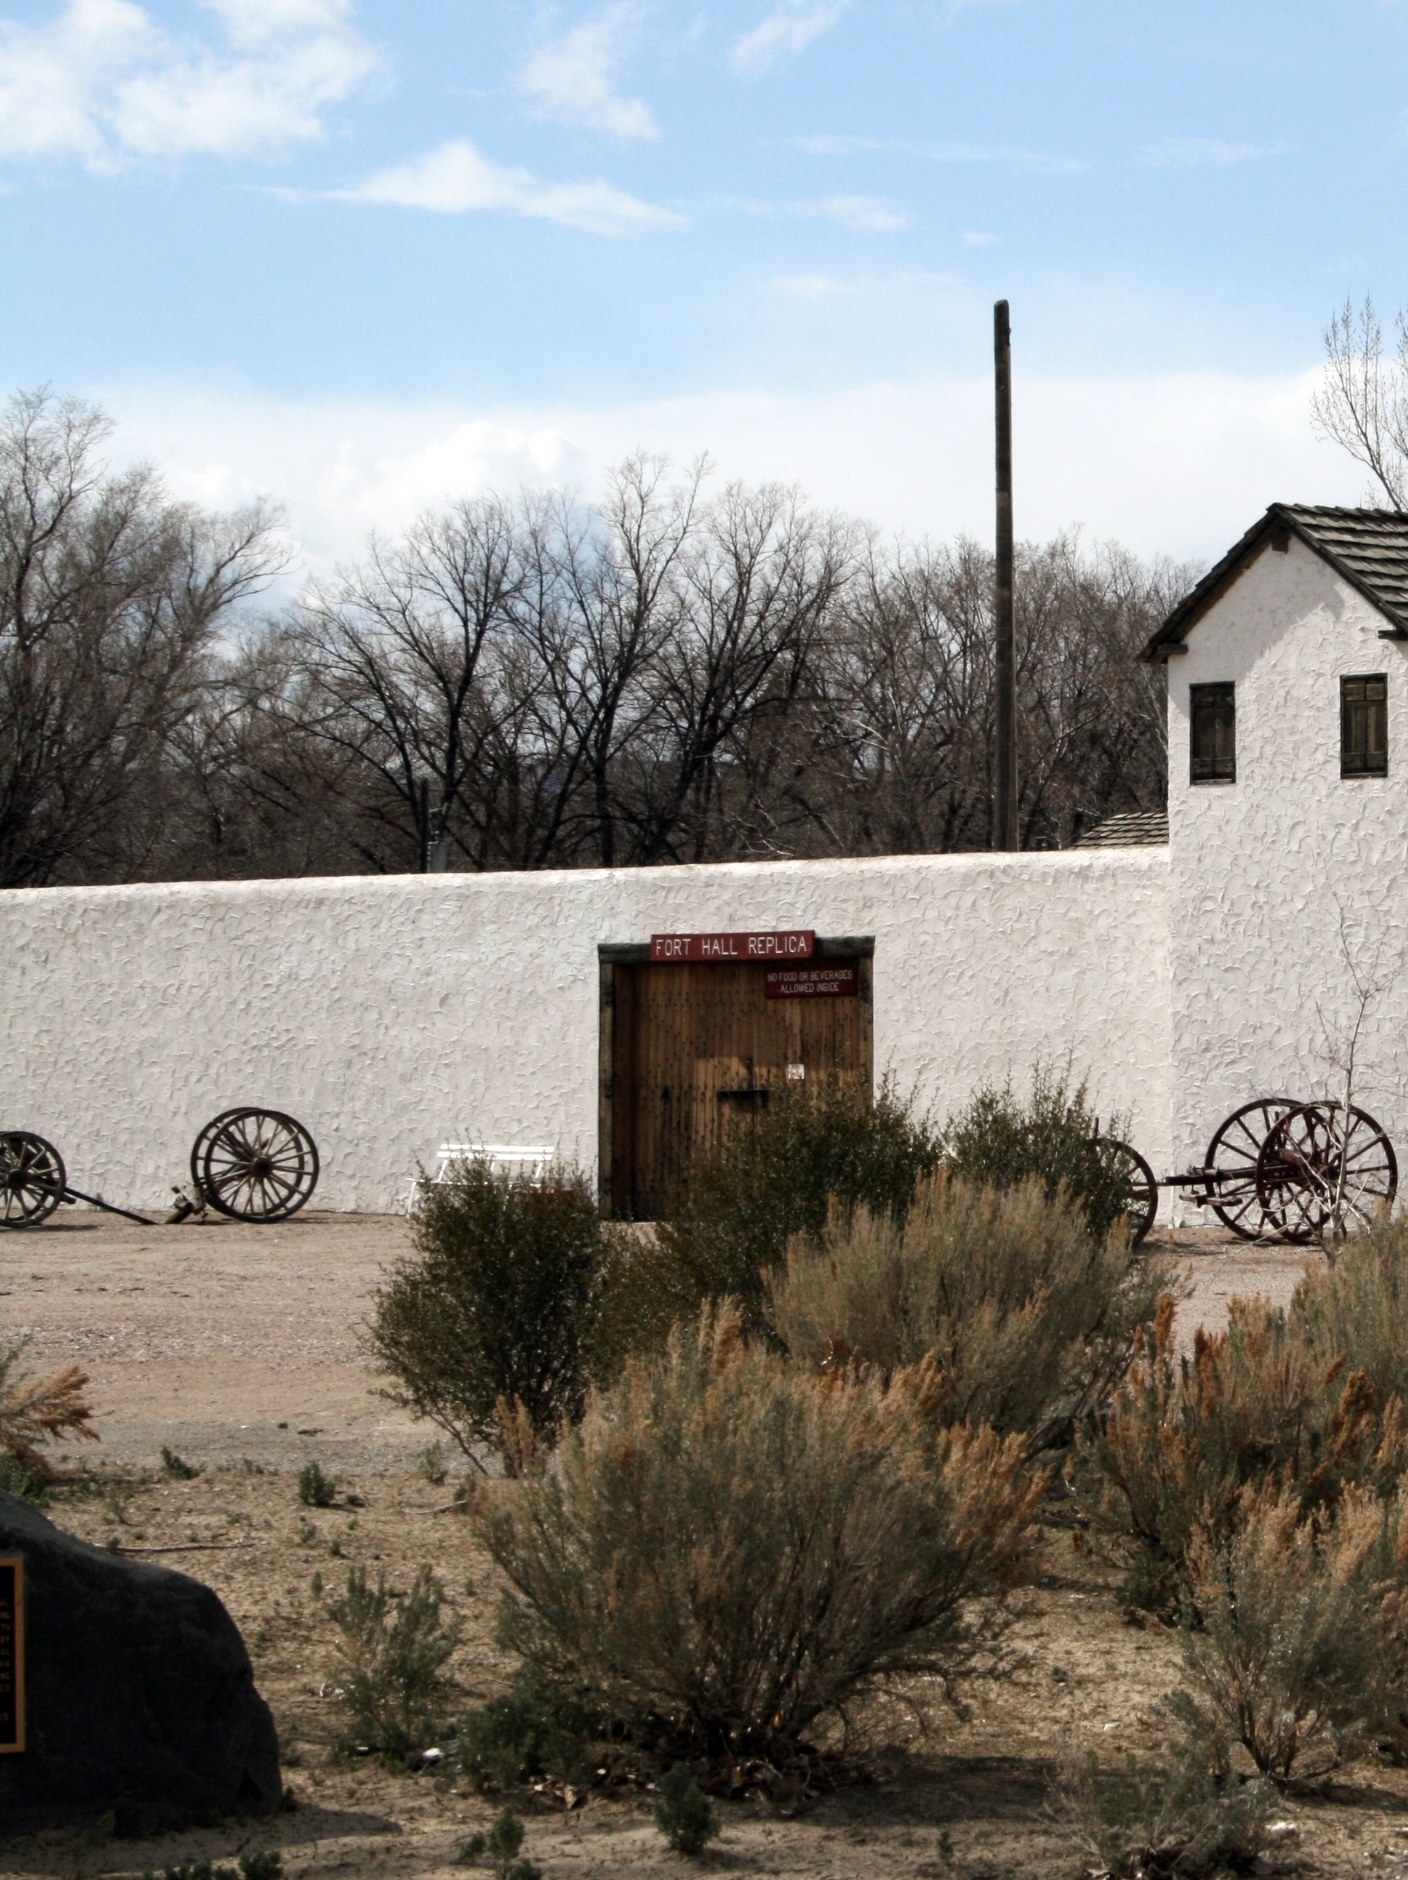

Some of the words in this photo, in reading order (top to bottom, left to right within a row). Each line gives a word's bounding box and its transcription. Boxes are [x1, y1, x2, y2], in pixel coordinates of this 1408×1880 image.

[655, 938, 692, 956] FORT
[701, 938, 738, 955] HALL
[748, 936, 807, 954] REPLICA
[767, 973, 777, 982] NO
[778, 972, 797, 981] FOOD
[799, 971, 808, 981] OR
[810, 970, 853, 980] BEVERAGES
[780, 983, 814, 993] ALLOWED
[816, 982, 839, 991] INSIDE
